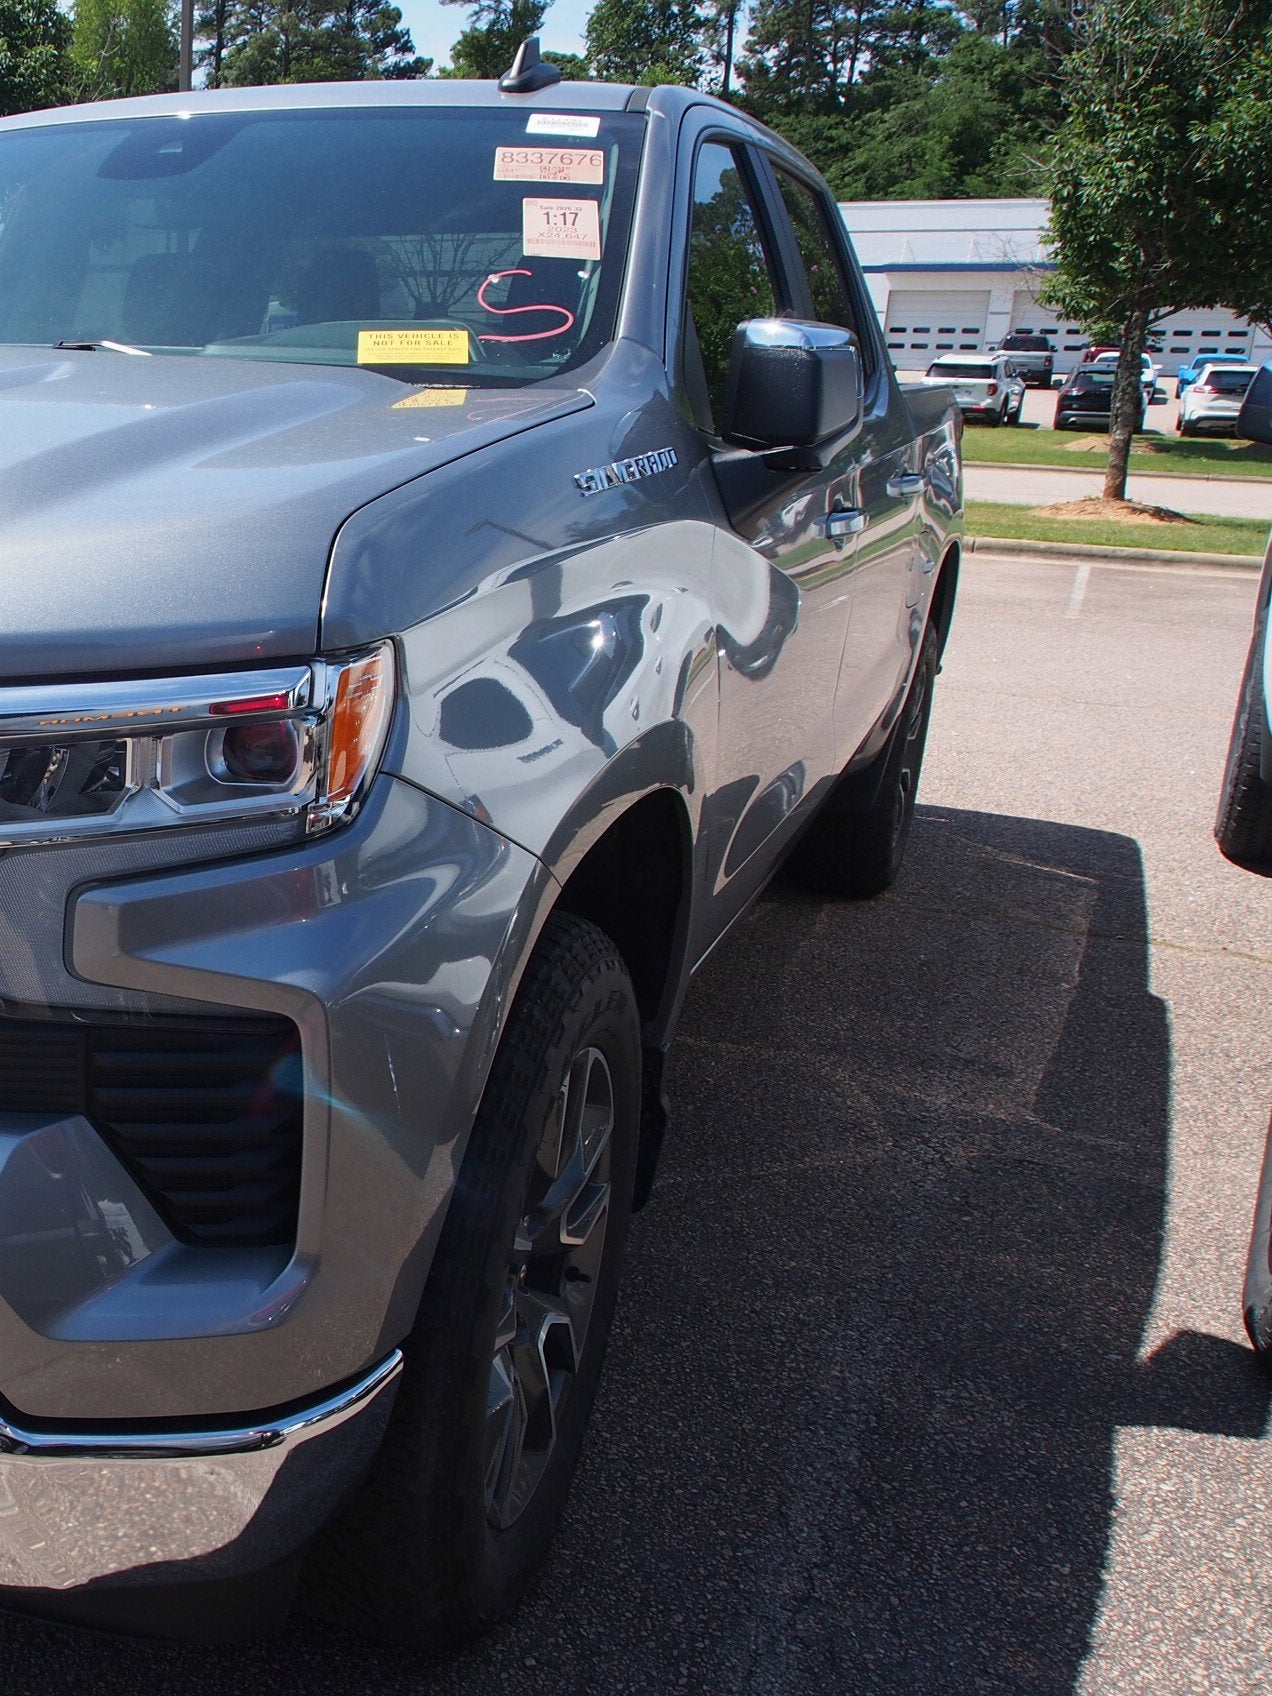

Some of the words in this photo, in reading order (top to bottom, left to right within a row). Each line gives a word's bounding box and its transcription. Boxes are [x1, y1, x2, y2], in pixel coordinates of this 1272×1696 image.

[501, 151, 602, 167] 8337676
[543, 211, 579, 226] 1:17
[572, 446, 679, 498] SILVERADO
